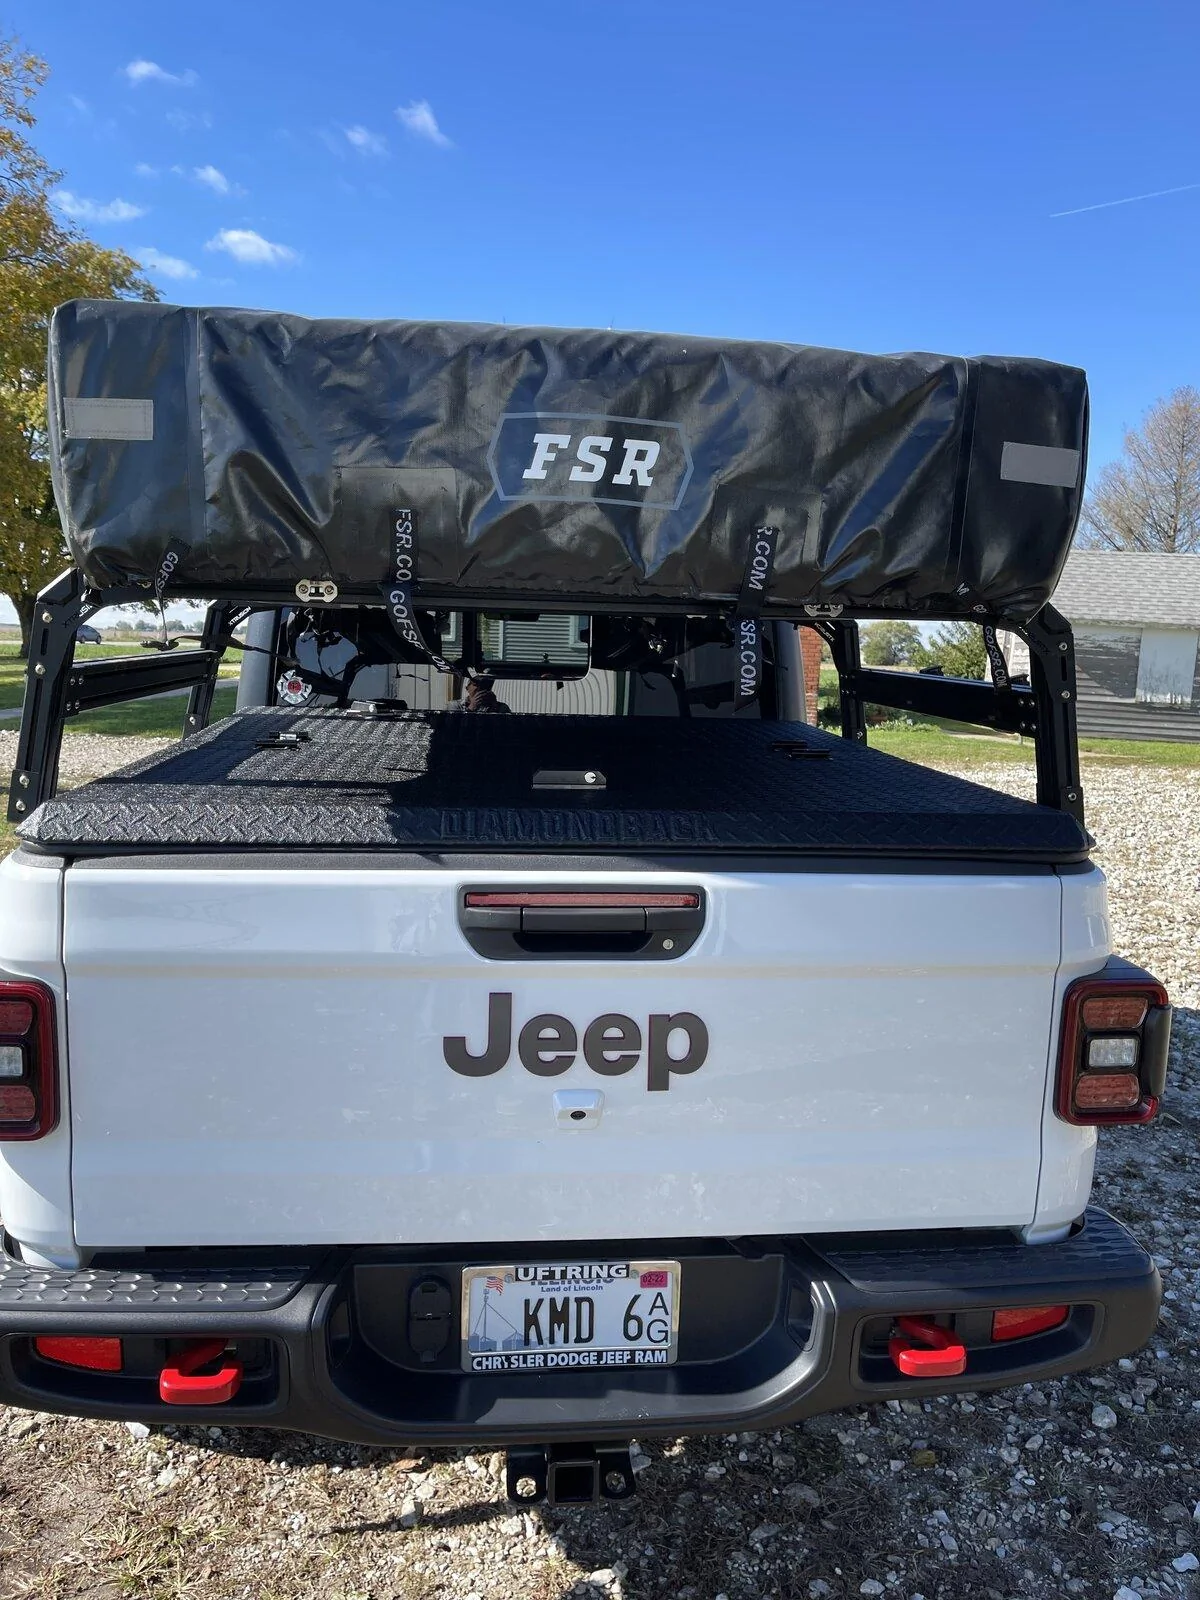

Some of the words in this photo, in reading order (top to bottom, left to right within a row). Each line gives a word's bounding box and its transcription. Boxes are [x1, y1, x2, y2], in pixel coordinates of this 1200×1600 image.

[522, 433, 661, 487] FSR
[395, 508, 413, 583] FSR.CO
[439, 808, 718, 841] DIAMONDBACK
[443, 992, 709, 1091] Jeep
[516, 1264, 627, 1281] UFTRING
[523, 1296, 595, 1347] KMD
[622, 1293, 644, 1342] 6
[547, 1351, 598, 1367] DODGE
[599, 1350, 631, 1365] JEEP
[634, 1350, 667, 1364] RAM
